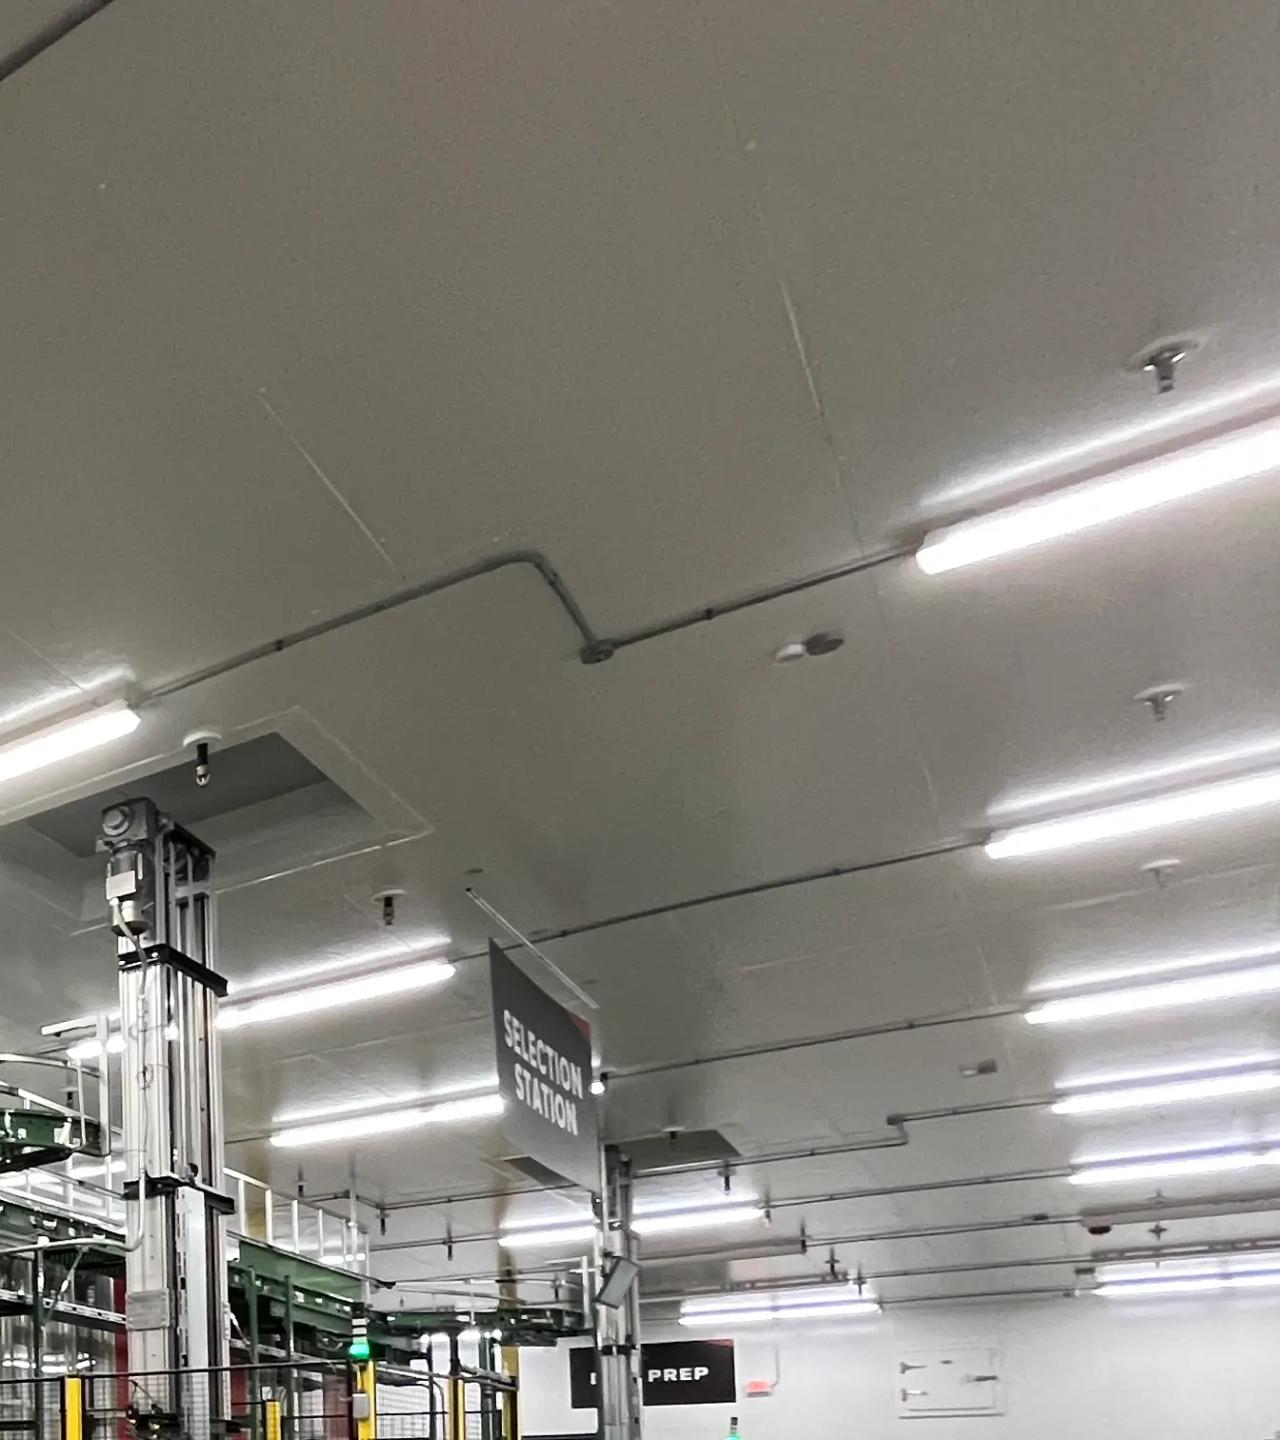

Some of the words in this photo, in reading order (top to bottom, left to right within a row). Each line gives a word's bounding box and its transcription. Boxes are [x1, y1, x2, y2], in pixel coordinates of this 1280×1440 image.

[503, 1009, 583, 1100] SELECTION
[515, 1063, 578, 1135] STATION
[647, 1366, 710, 1383] PREP
